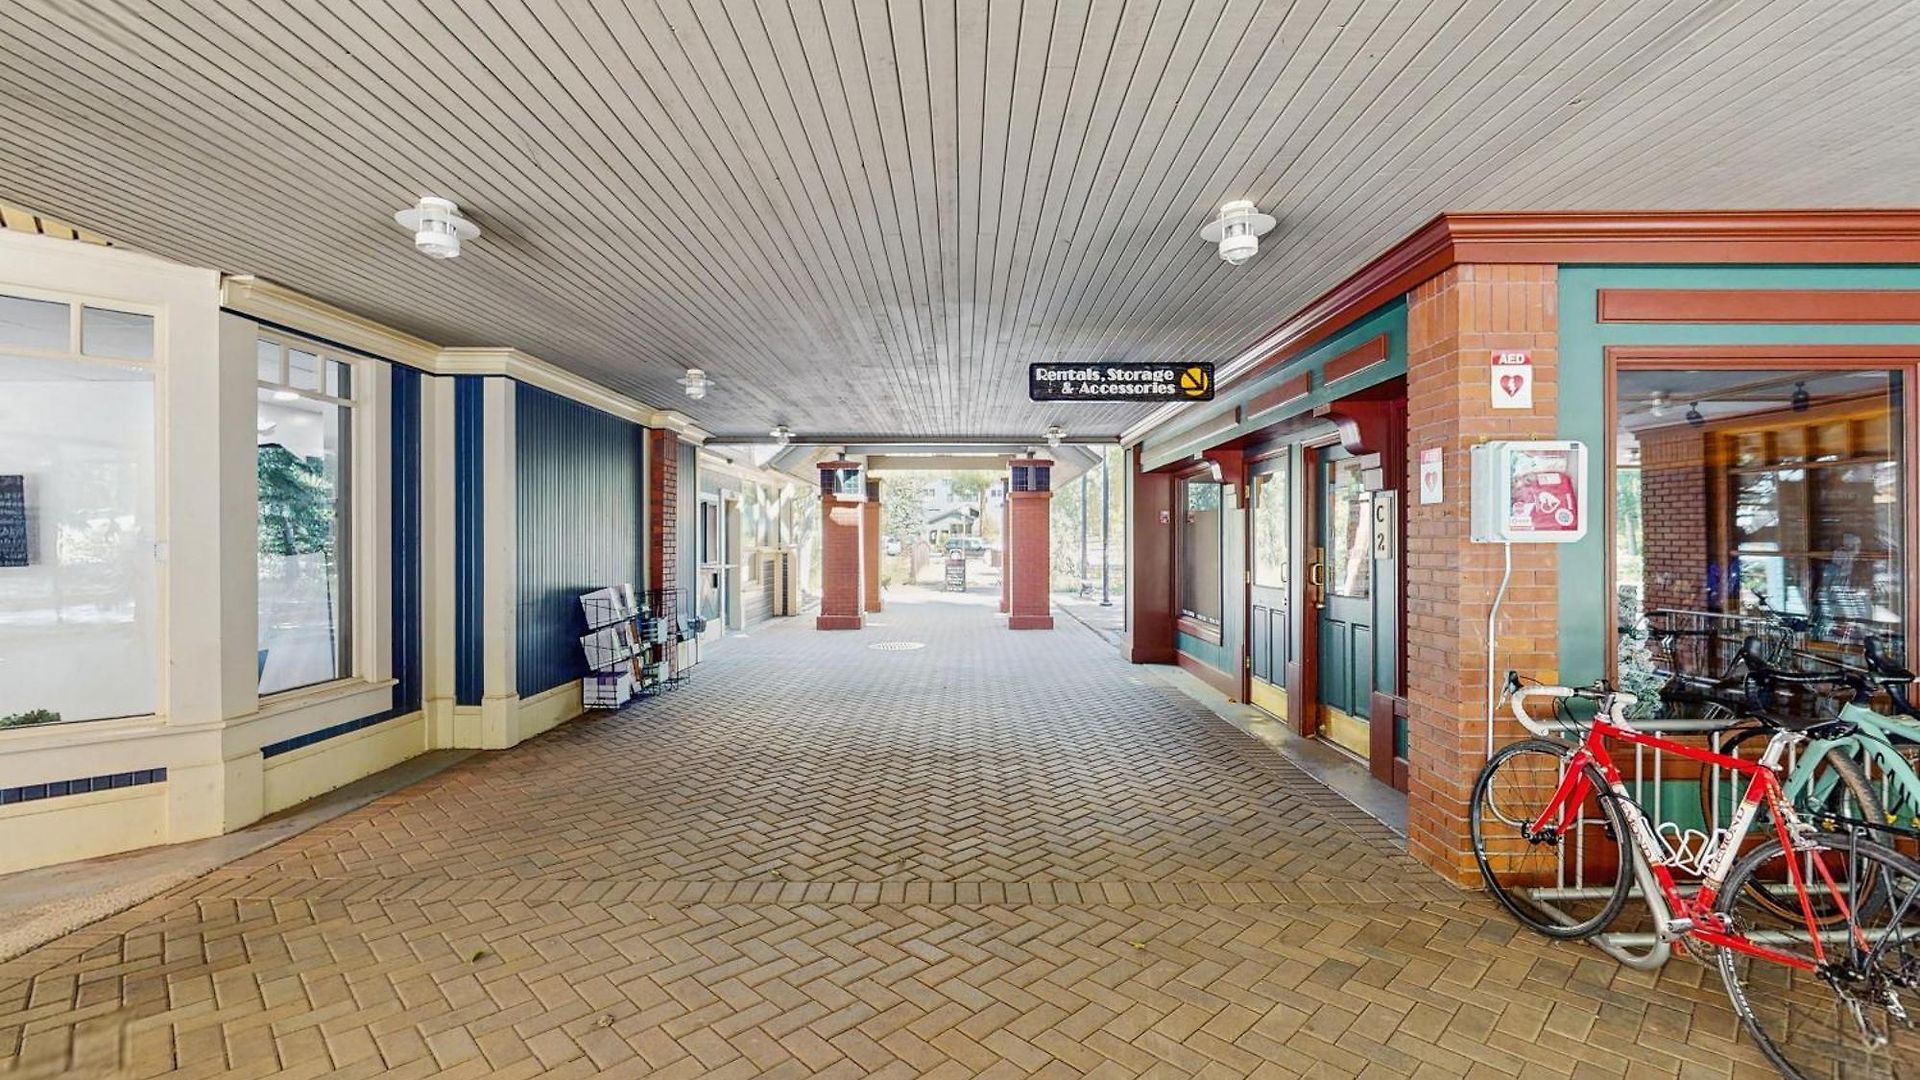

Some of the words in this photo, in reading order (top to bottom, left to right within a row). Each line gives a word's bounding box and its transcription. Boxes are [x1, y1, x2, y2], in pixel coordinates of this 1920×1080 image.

[1498, 353, 1525, 365] AED
[1107, 367, 1174, 383] Storage
[1061, 382, 1074, 395] &
[1078, 382, 1176, 395] Accessories
[1620, 801, 1652, 858] EMOND
[1707, 807, 1744, 873] LEMOND
